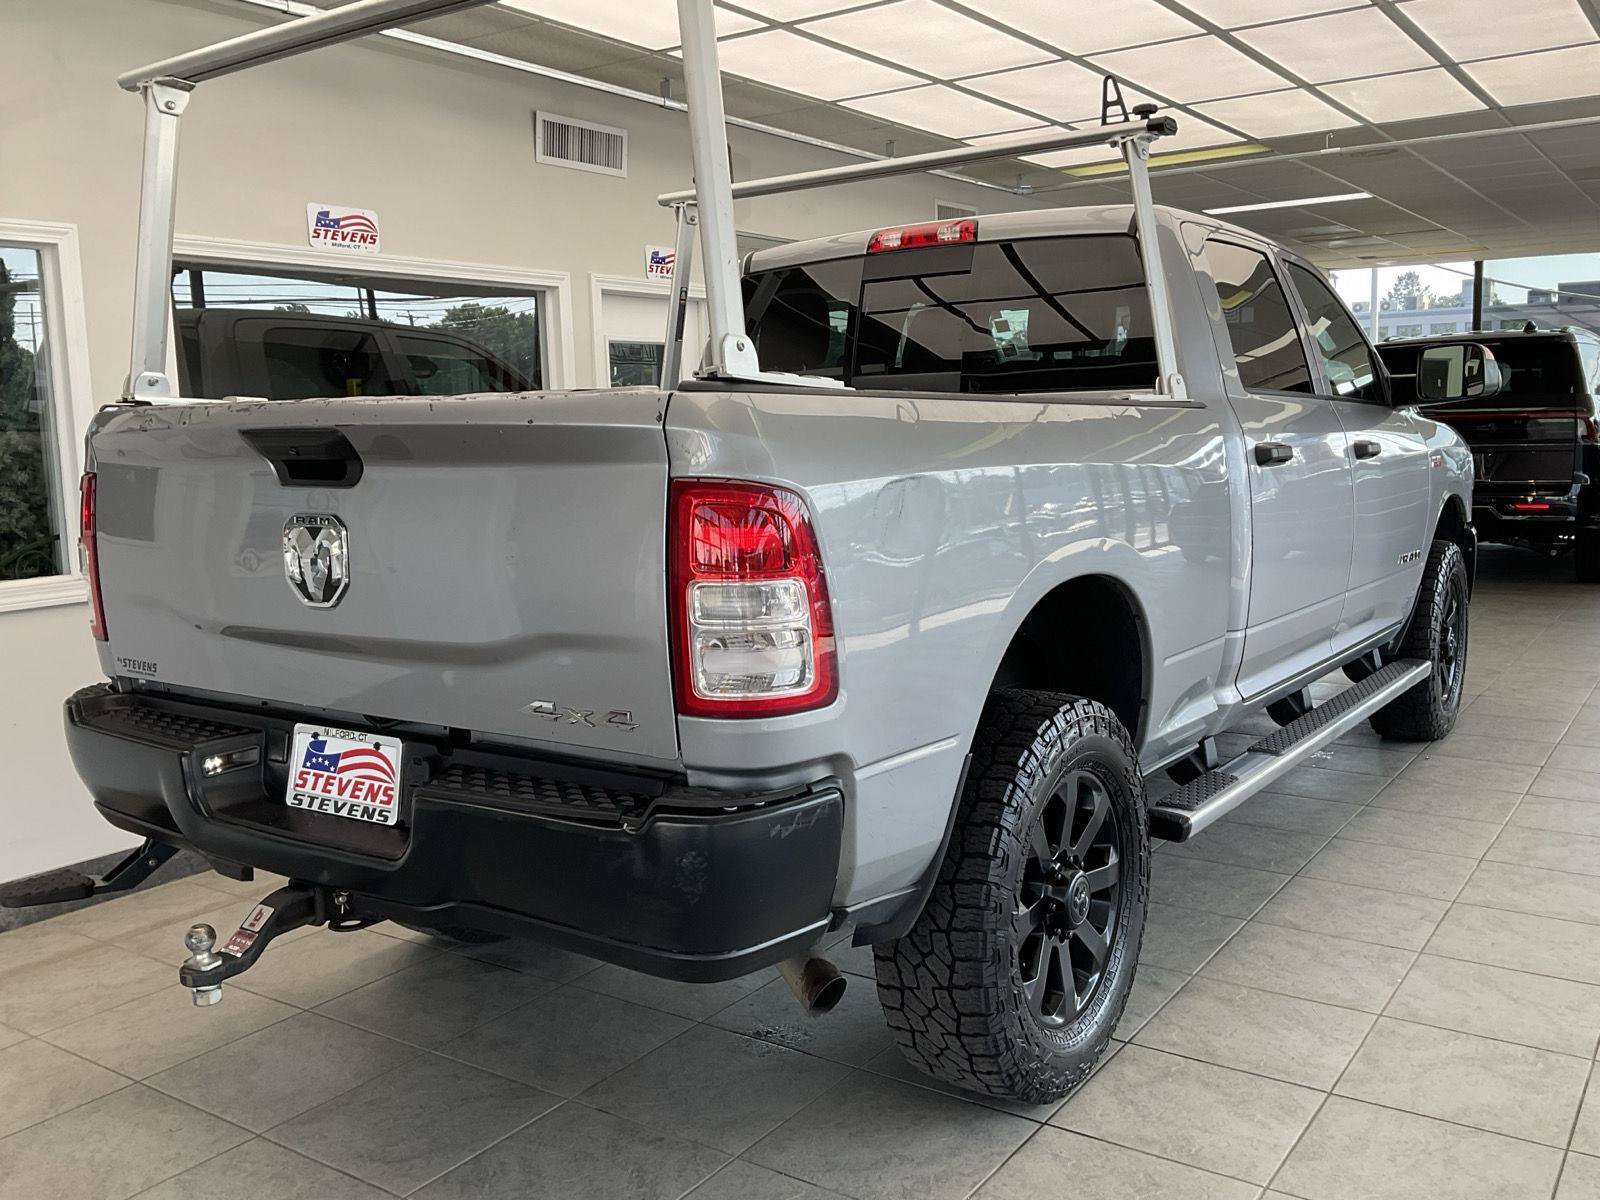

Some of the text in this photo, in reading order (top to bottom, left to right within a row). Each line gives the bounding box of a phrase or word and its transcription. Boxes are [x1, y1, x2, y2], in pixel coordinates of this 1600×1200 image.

[311, 228, 378, 245] STEVENS
[293, 515, 330, 526] RAM
[122, 658, 157, 673] STEVENS
[323, 727, 368, 742] MILFORD, CT
[295, 770, 395, 806] STEVENS
[290, 792, 391, 823] STEVENS
